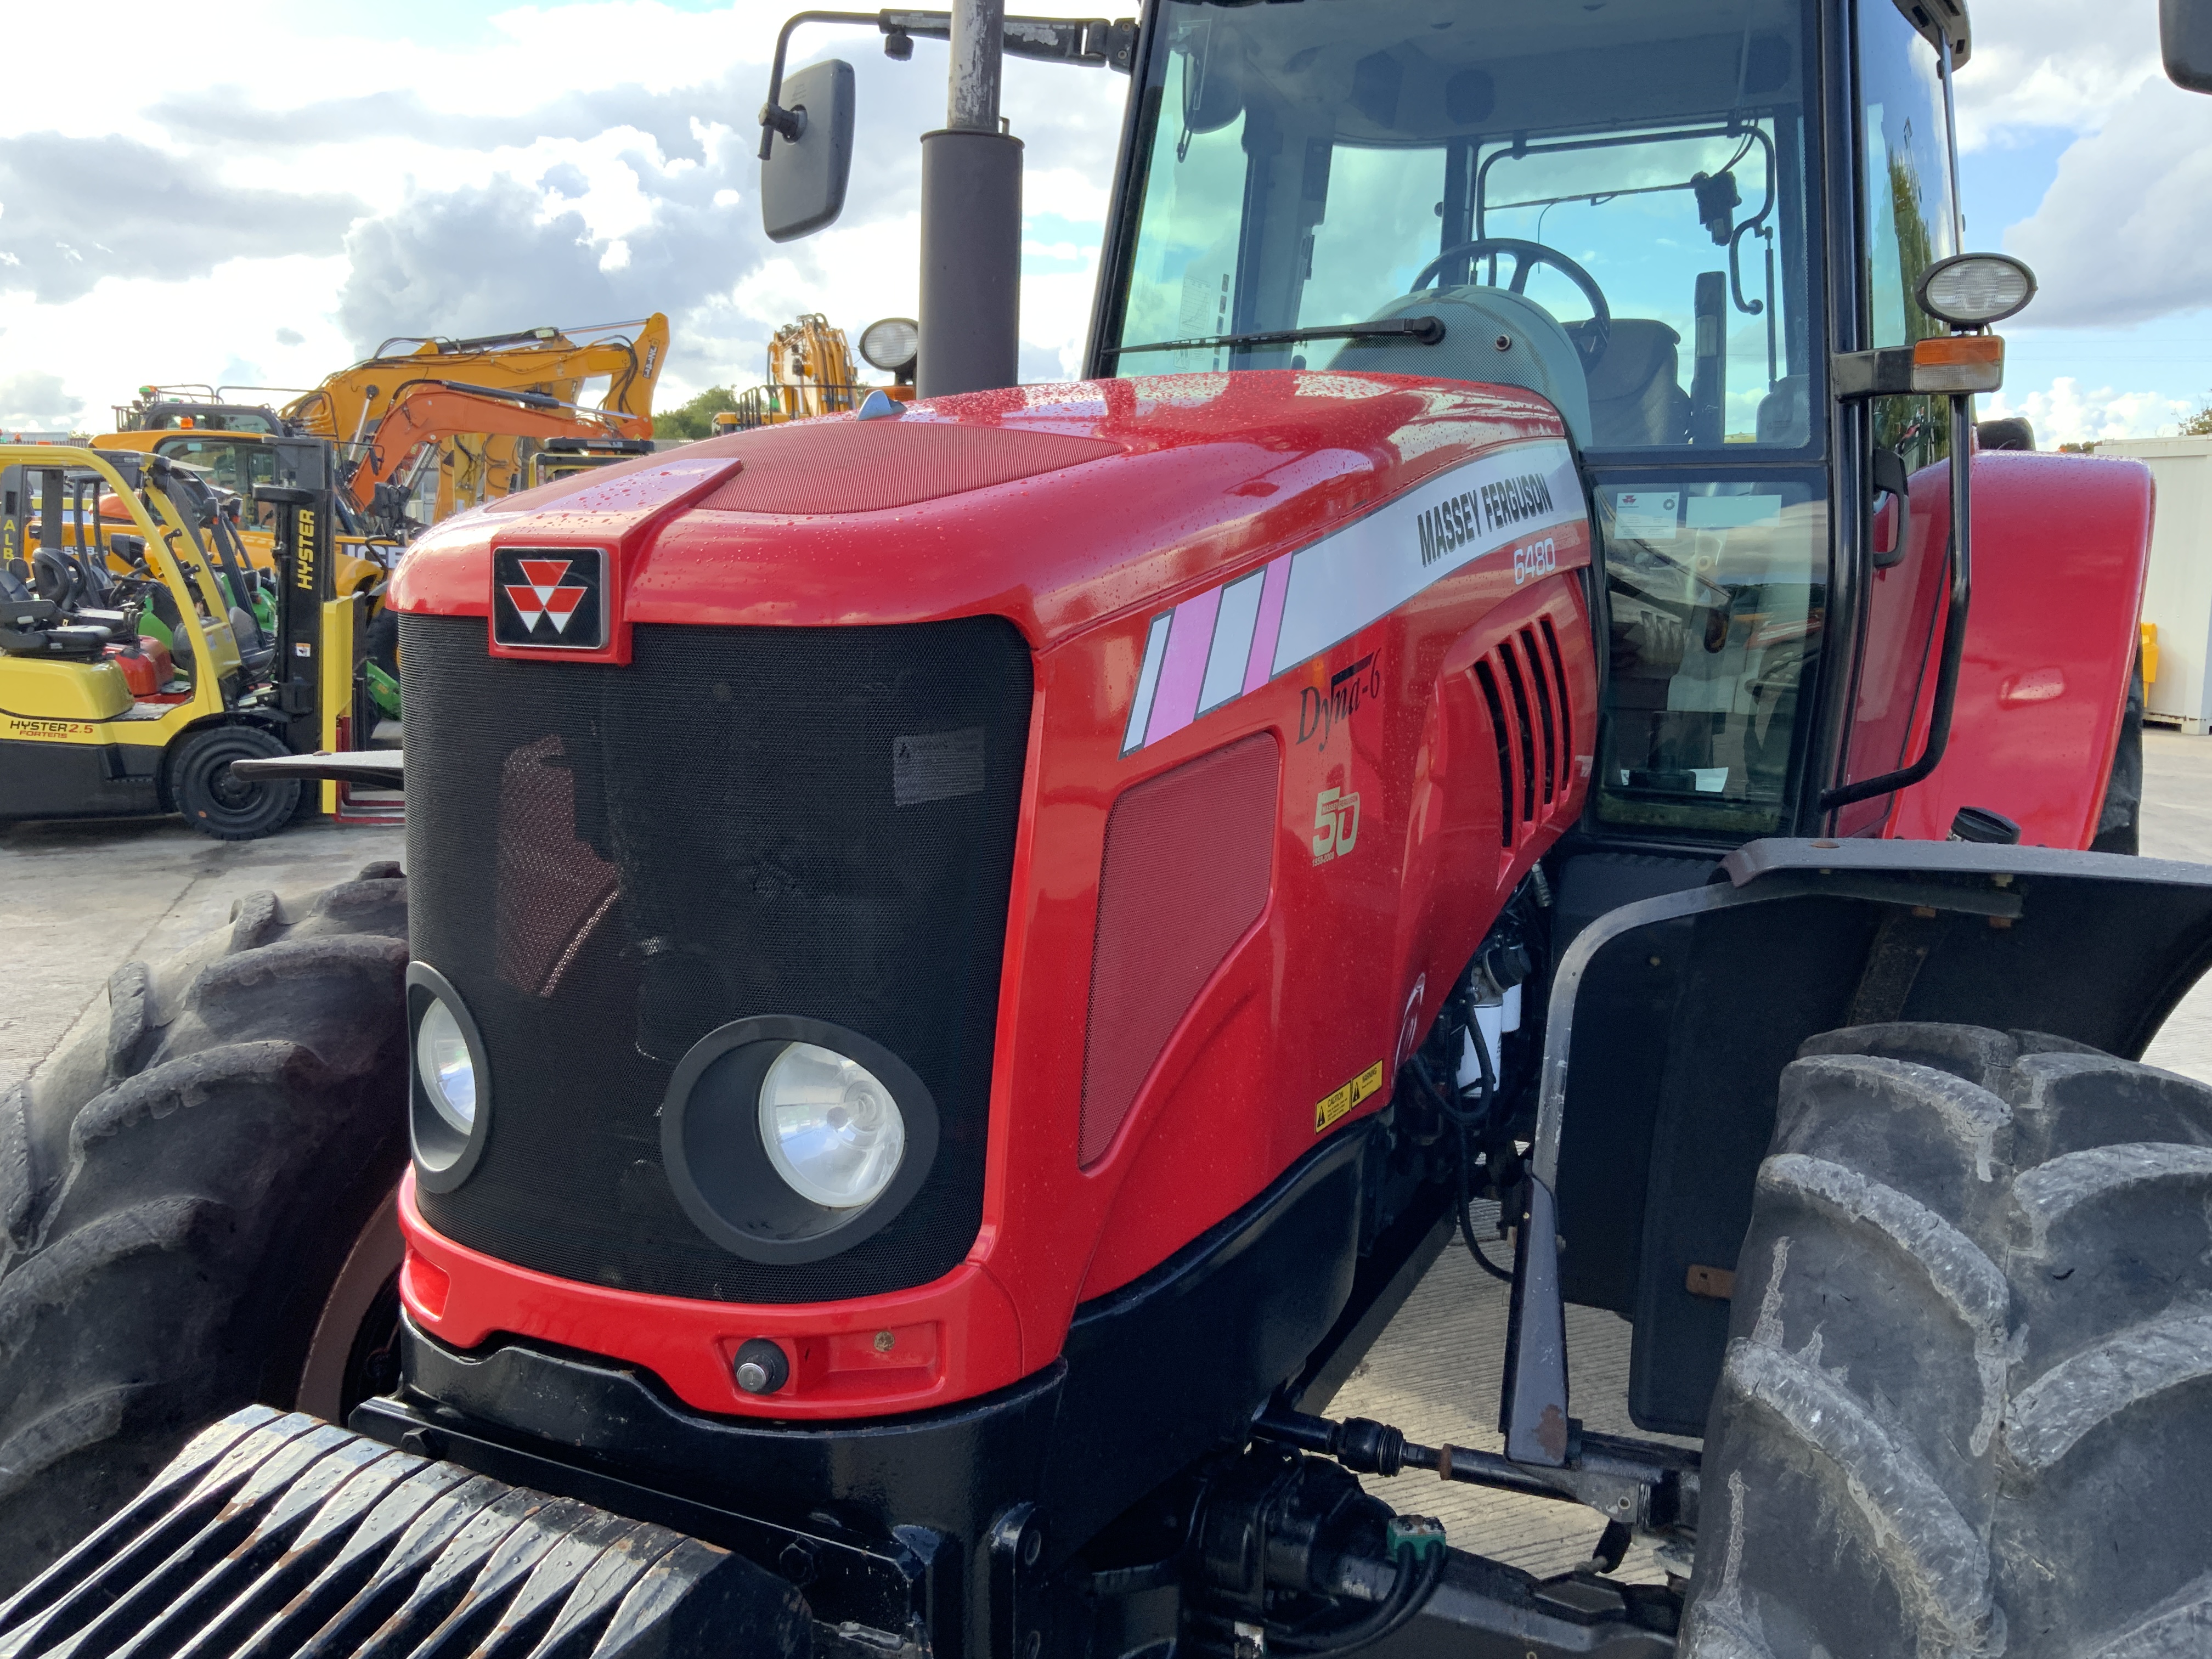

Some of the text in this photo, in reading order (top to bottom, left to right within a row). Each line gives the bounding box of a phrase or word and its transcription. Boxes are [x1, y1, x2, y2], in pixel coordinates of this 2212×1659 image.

[1417, 473, 1554, 568] MASSEY FERGUSON
[297, 509, 314, 590] HYSTER
[1514, 538, 1555, 585] 6480
[1296, 647, 1381, 752] Dyna-6
[10, 720, 94, 733] HYSTER 2.5
[20, 730, 67, 738] FORTENS
[1313, 786, 1360, 856] 50
[1322, 795, 1358, 814] MASSEY FERGUSON
[1328, 1091, 1344, 1107] CAUTION
